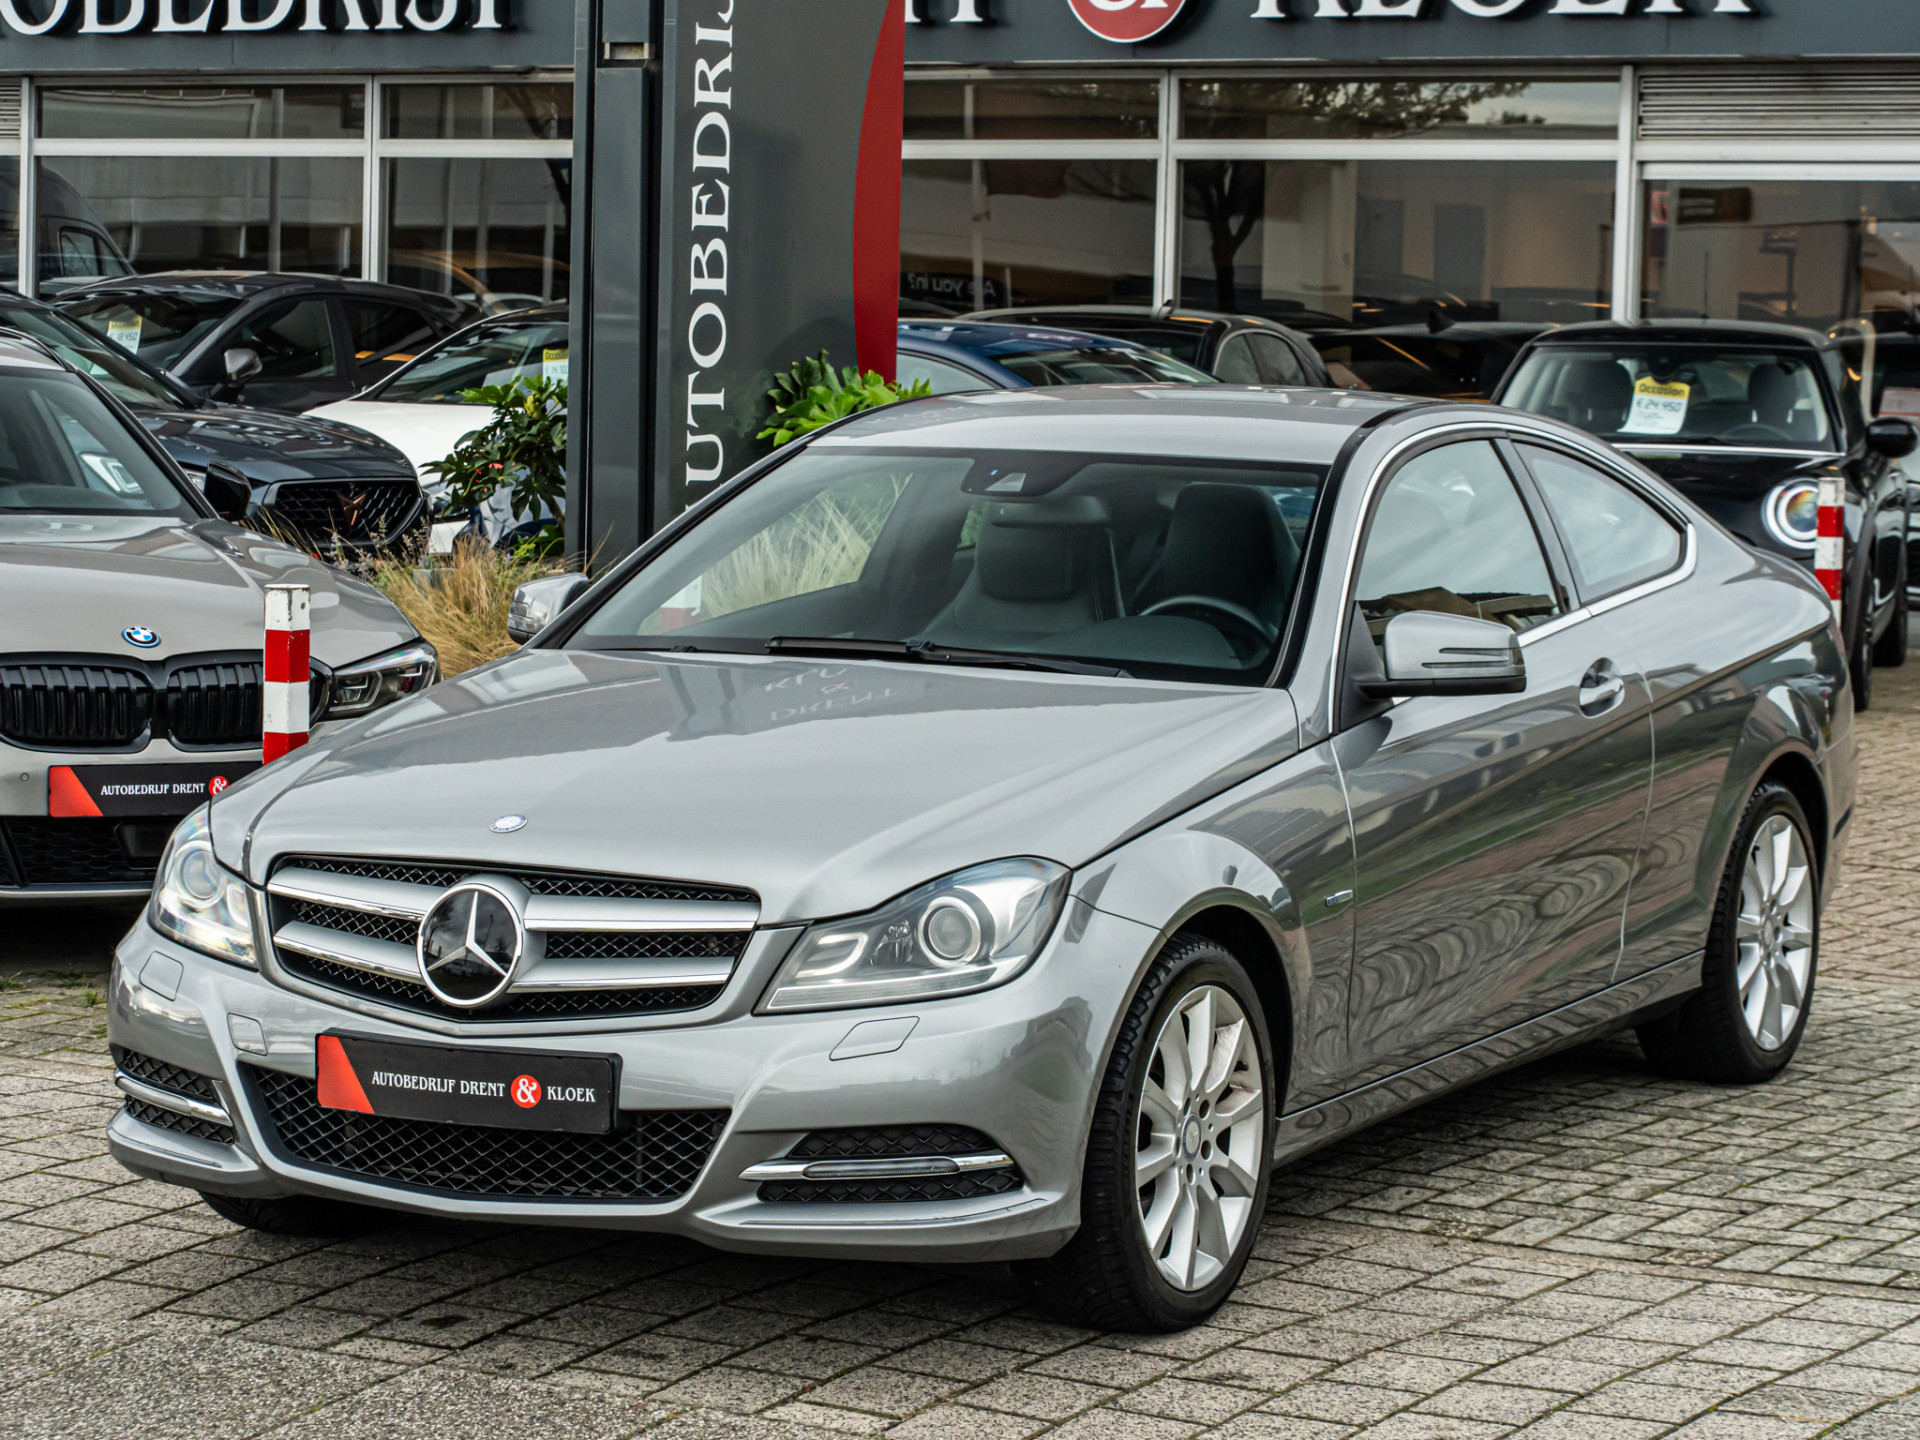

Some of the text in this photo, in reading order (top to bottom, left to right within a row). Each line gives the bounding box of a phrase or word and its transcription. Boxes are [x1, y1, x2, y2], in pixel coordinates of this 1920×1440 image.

[685, 0, 734, 511] UTOBEDRI
[1639, 383, 1685, 396] Occasion
[100, 783, 170, 796] AUTOBEDRIJF
[172, 782, 206, 795] DRENT
[371, 1070, 596, 1104] AUTOBEDRIJF DRENT & KLOEK
